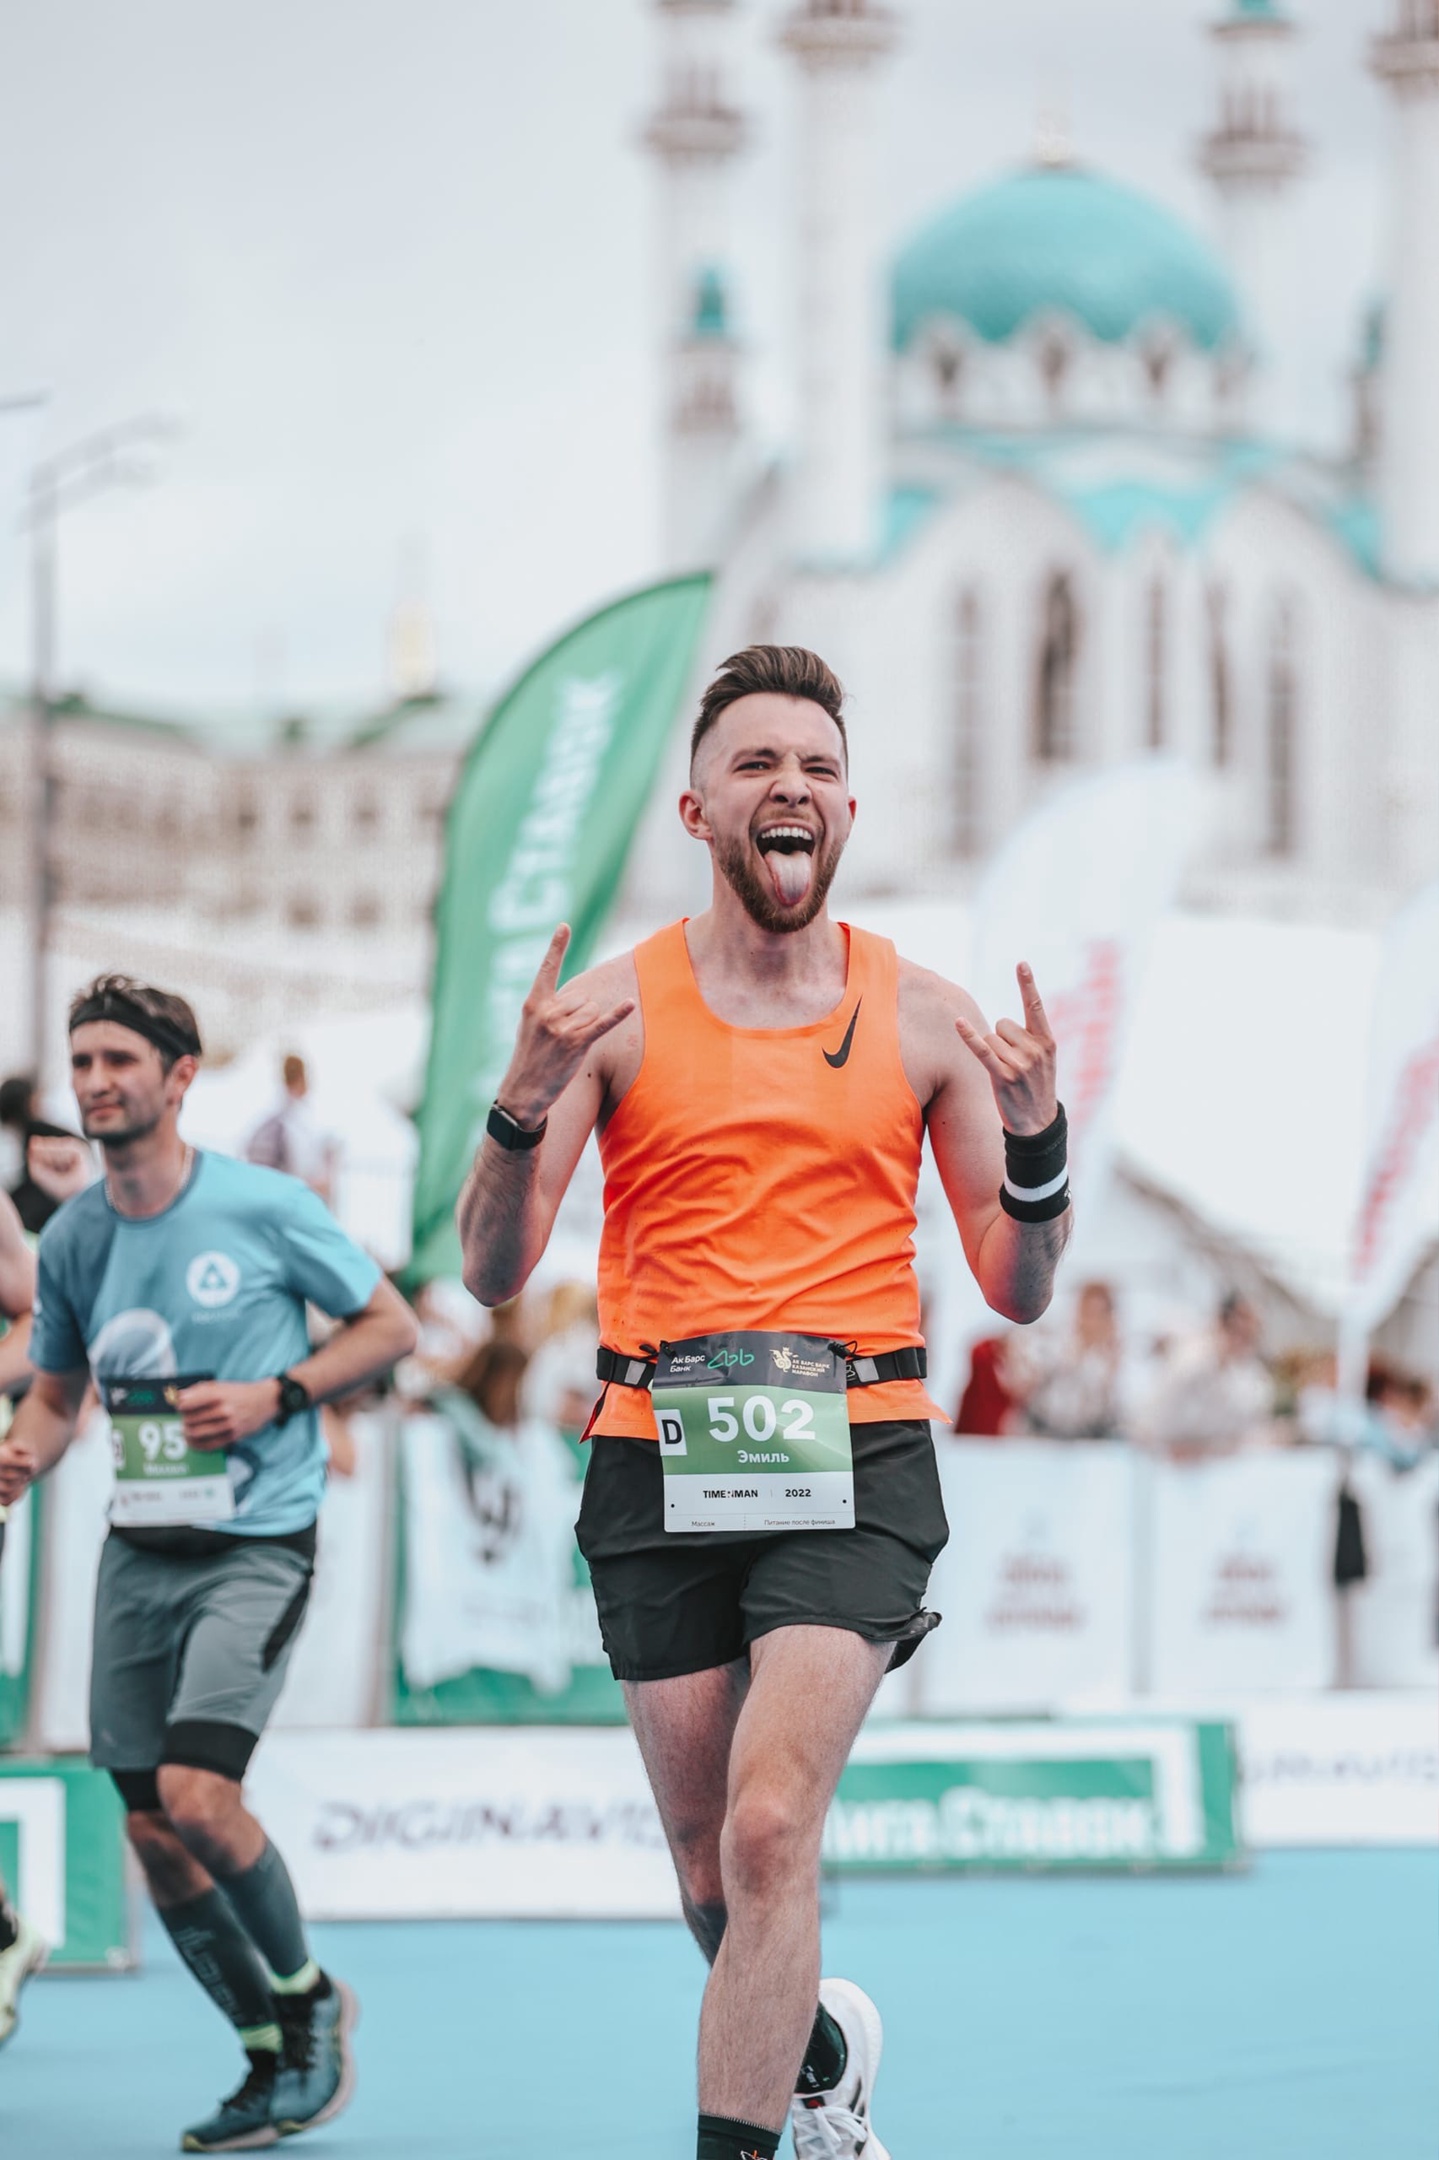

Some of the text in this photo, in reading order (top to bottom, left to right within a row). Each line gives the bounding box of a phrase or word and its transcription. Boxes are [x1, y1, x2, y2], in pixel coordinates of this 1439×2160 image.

[684, 1354, 706, 1366] Барс
[669, 1365, 692, 1373] Банк
[707, 1395, 816, 1442] 502
[661, 1419, 683, 1445] D
[737, 1450, 790, 1464] Эмиль
[784, 1488, 812, 1498] 2022
